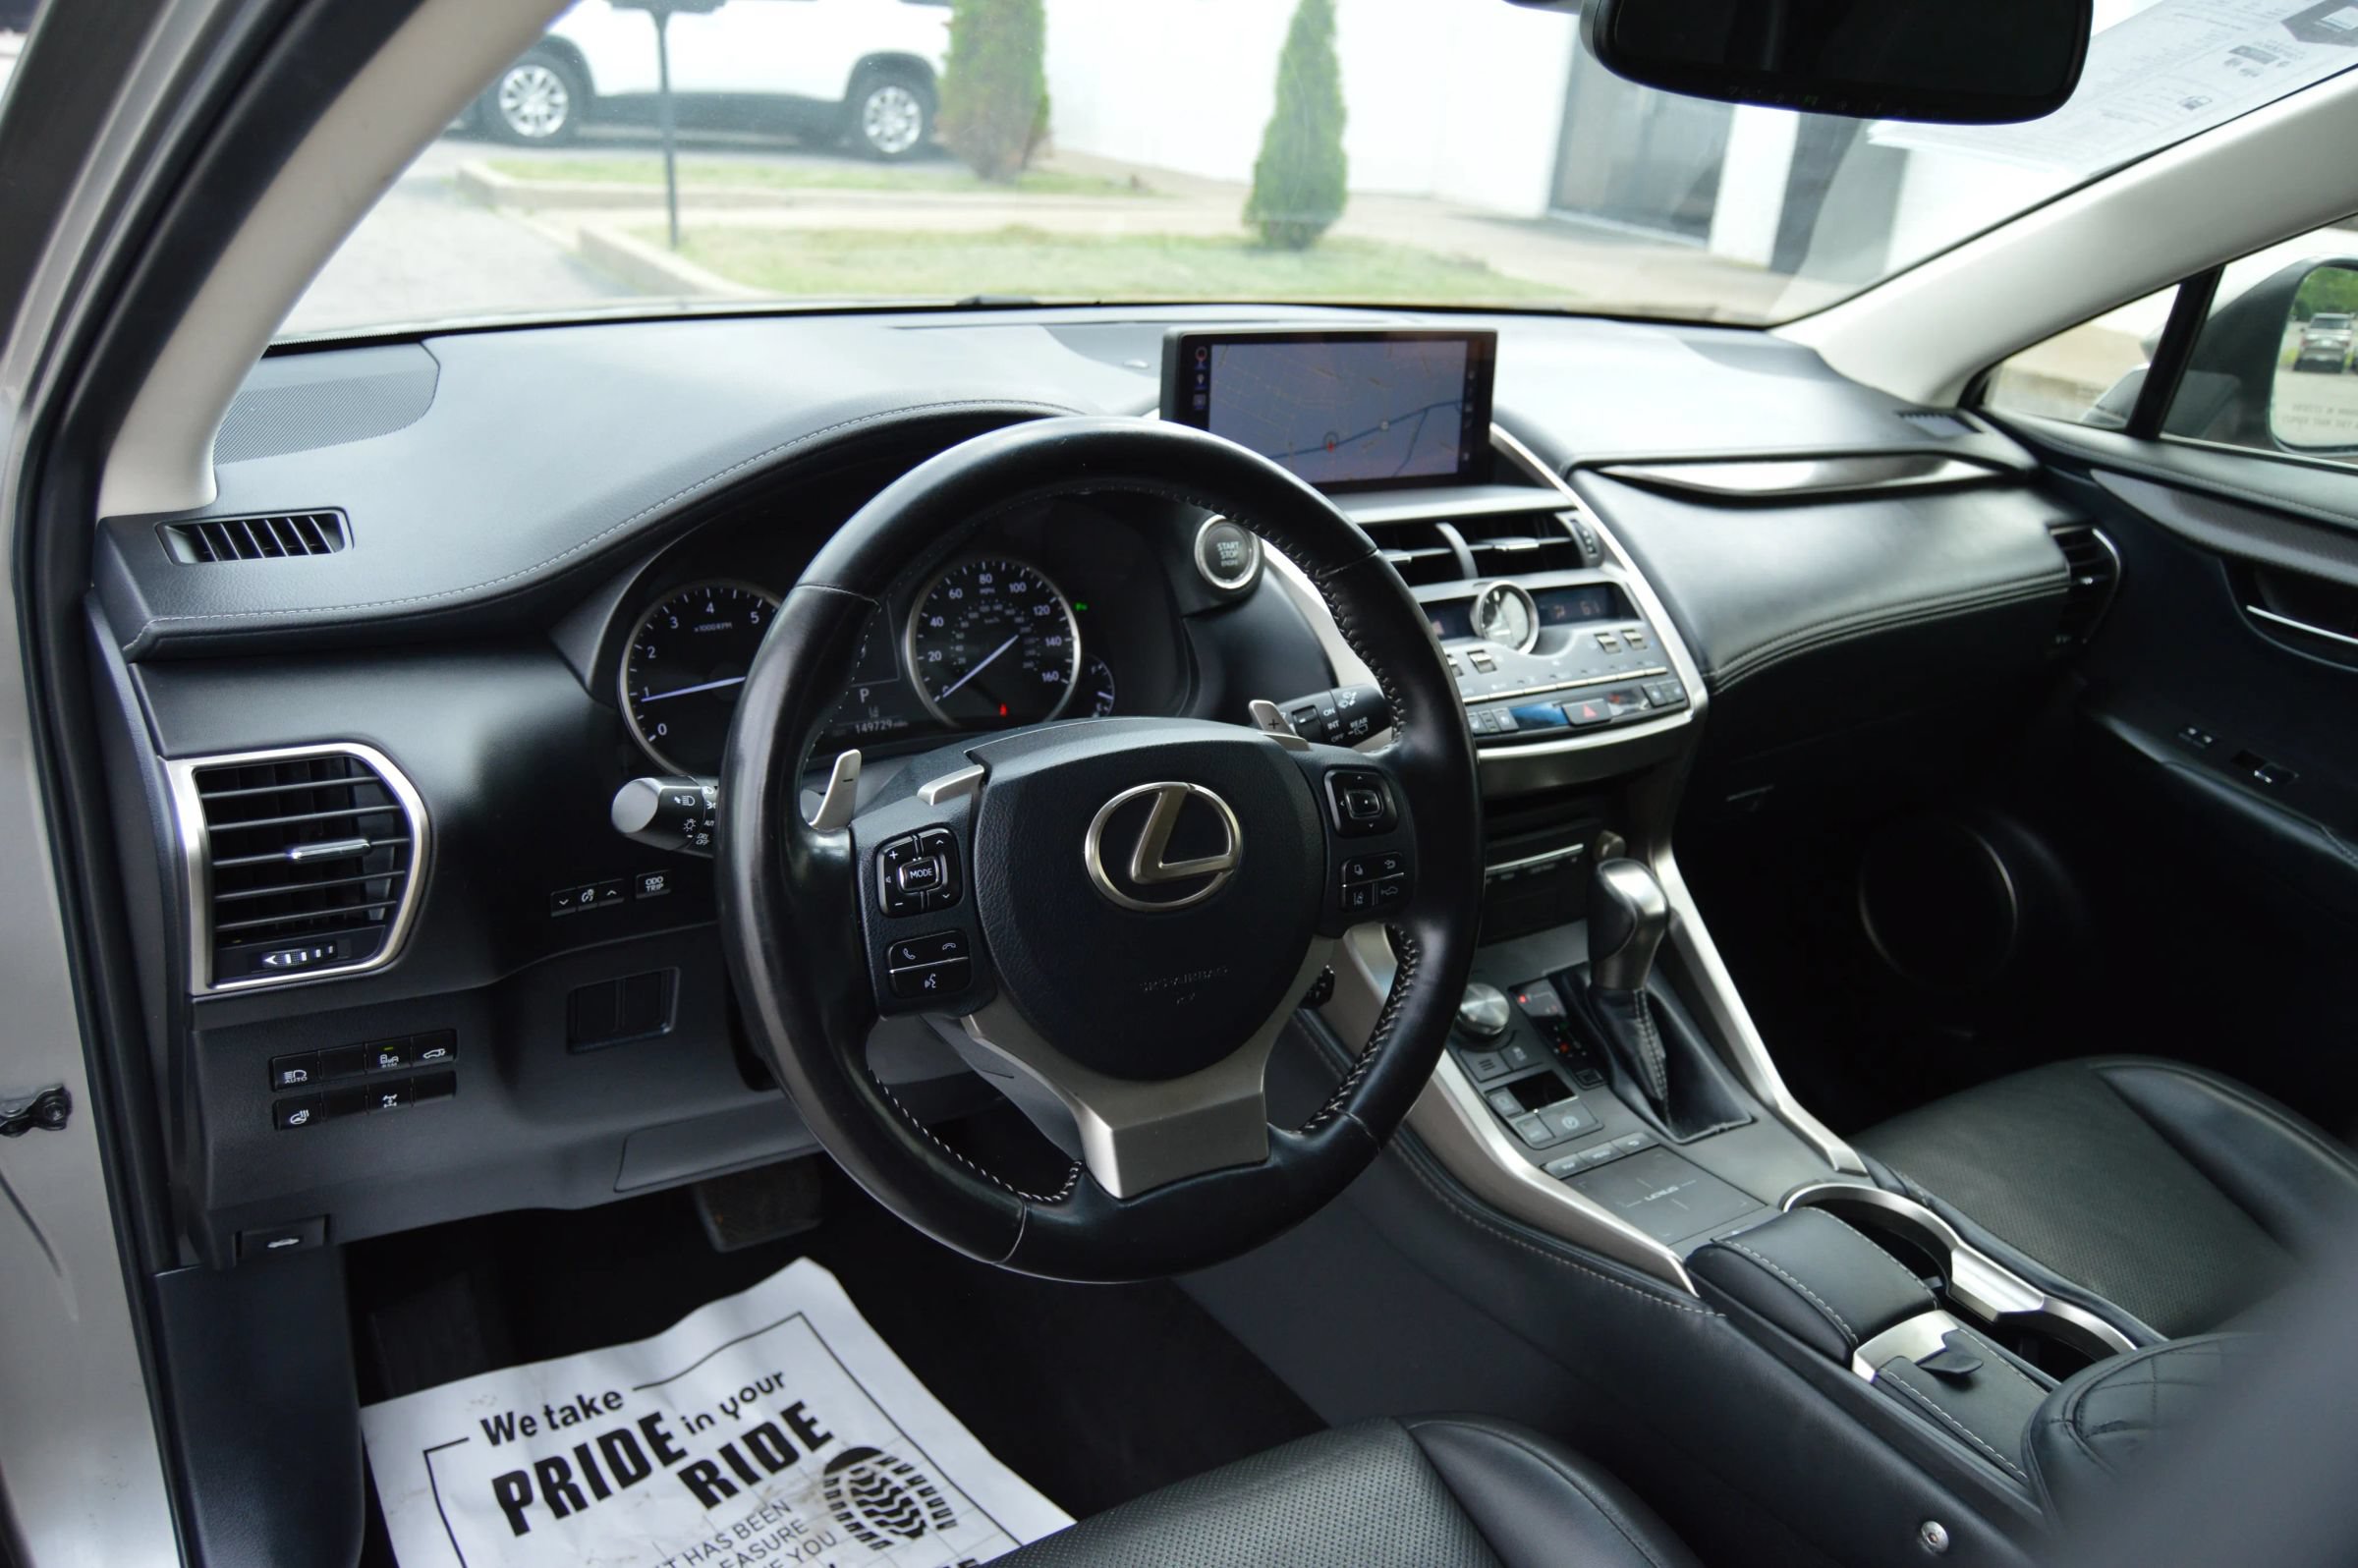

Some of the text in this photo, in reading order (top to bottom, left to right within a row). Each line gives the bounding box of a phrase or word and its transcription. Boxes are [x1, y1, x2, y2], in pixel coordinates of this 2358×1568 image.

[978, 573, 993, 586] 80
[948, 588, 964, 599] 60
[1008, 581, 1028, 593] 100
[705, 601, 715, 614] 4
[1032, 604, 1051, 616] 120
[669, 616, 680, 629] 3
[750, 610, 760, 624] 5
[929, 615, 945, 628] 40
[1044, 635, 1062, 647] 140
[646, 645, 657, 659] 2
[927, 650, 942, 663] 20
[1040, 670, 1060, 683] 160
[859, 688, 870, 704] P
[1322, 707, 1336, 716] ON
[656, 722, 669, 736] 0
[909, 868, 934, 880] MODE
[645, 883, 665, 893] TRIP
[284, 1076, 308, 1085] AUTO
[480, 1391, 625, 1446] We take
[491, 1371, 786, 1538] PRIDE in your
[677, 1401, 834, 1510] RIDE
[682, 1532, 735, 1567] HAS
[731, 1499, 792, 1540] BEEN
[786, 1531, 838, 1565] YOU
